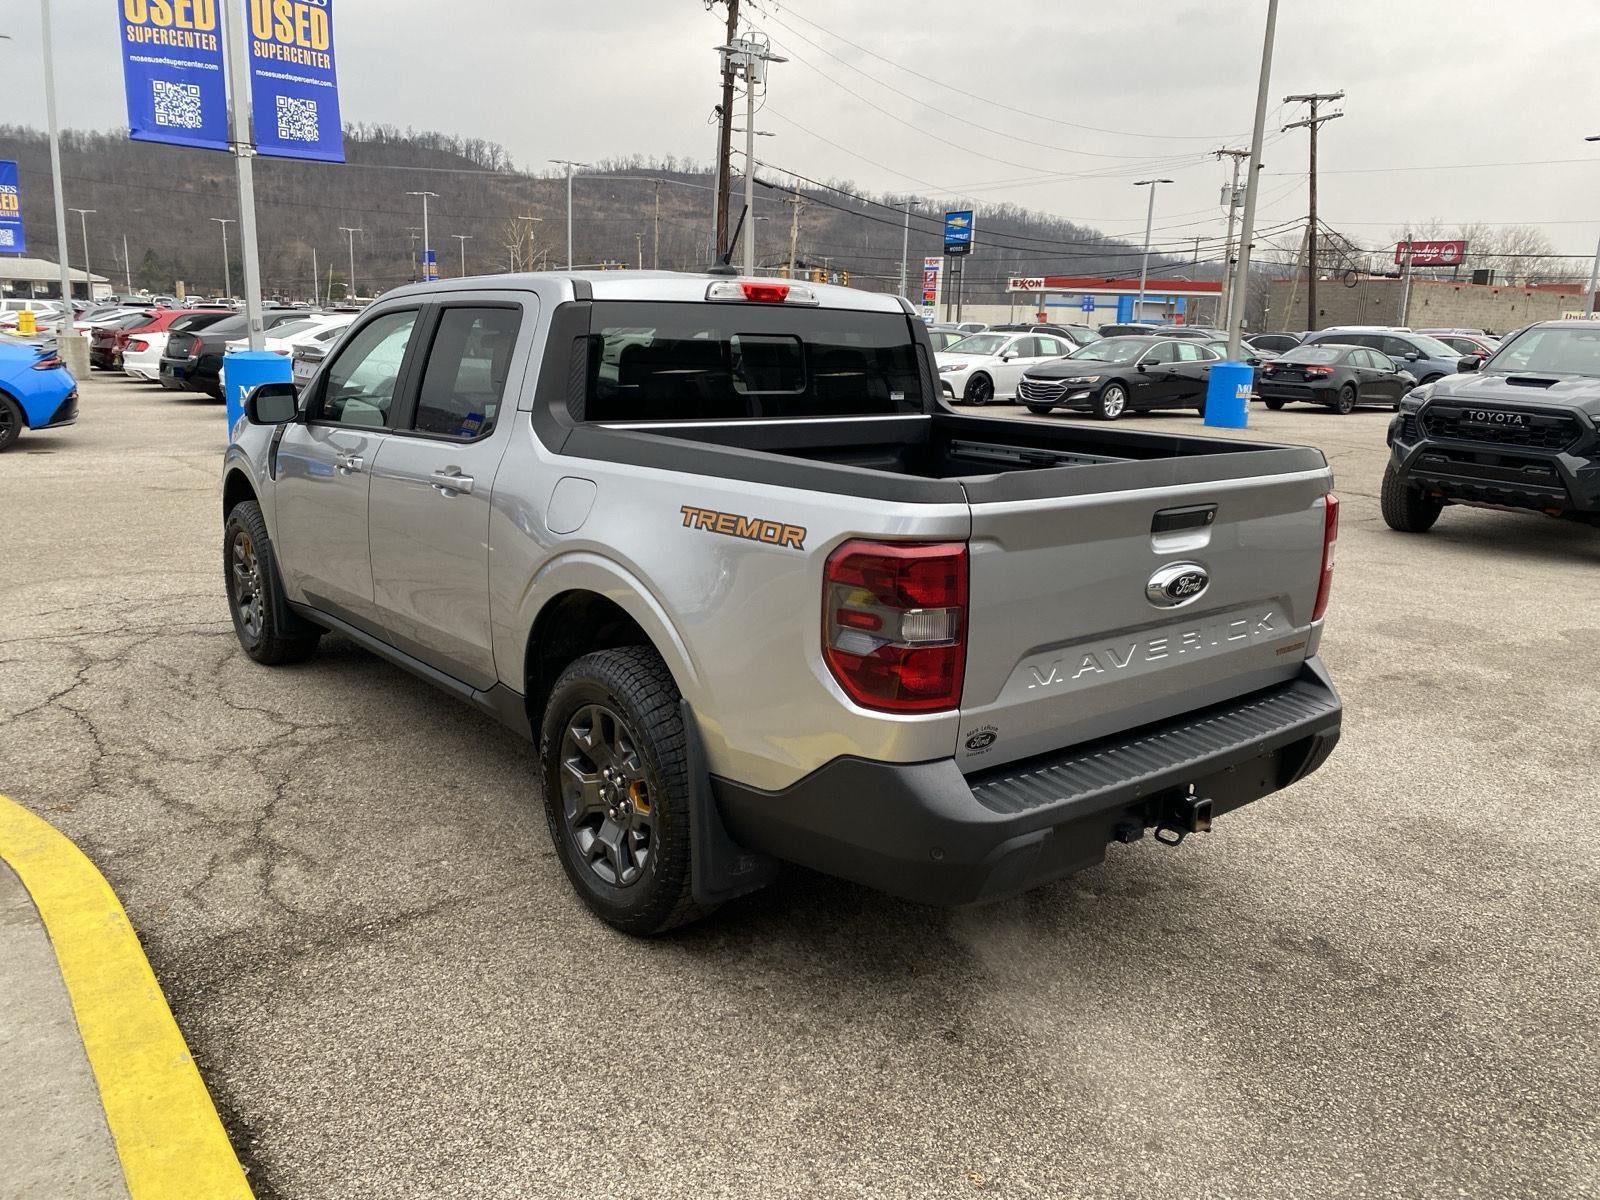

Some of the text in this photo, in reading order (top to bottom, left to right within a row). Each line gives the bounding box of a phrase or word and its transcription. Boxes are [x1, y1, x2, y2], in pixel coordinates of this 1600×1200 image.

[126, 25, 217, 51] SUPERCENTER
[251, 0, 330, 51] USED
[129, 55, 219, 70] mosesusedsupercenter.com
[253, 40, 331, 69] SUPERCENTER
[1012, 279, 1041, 290] EXXON
[1469, 411, 1522, 424] TOYOTA
[680, 505, 807, 551] TREMOR
[1175, 575, 1202, 595] Ford
[1028, 611, 1275, 689] MAVERICK
